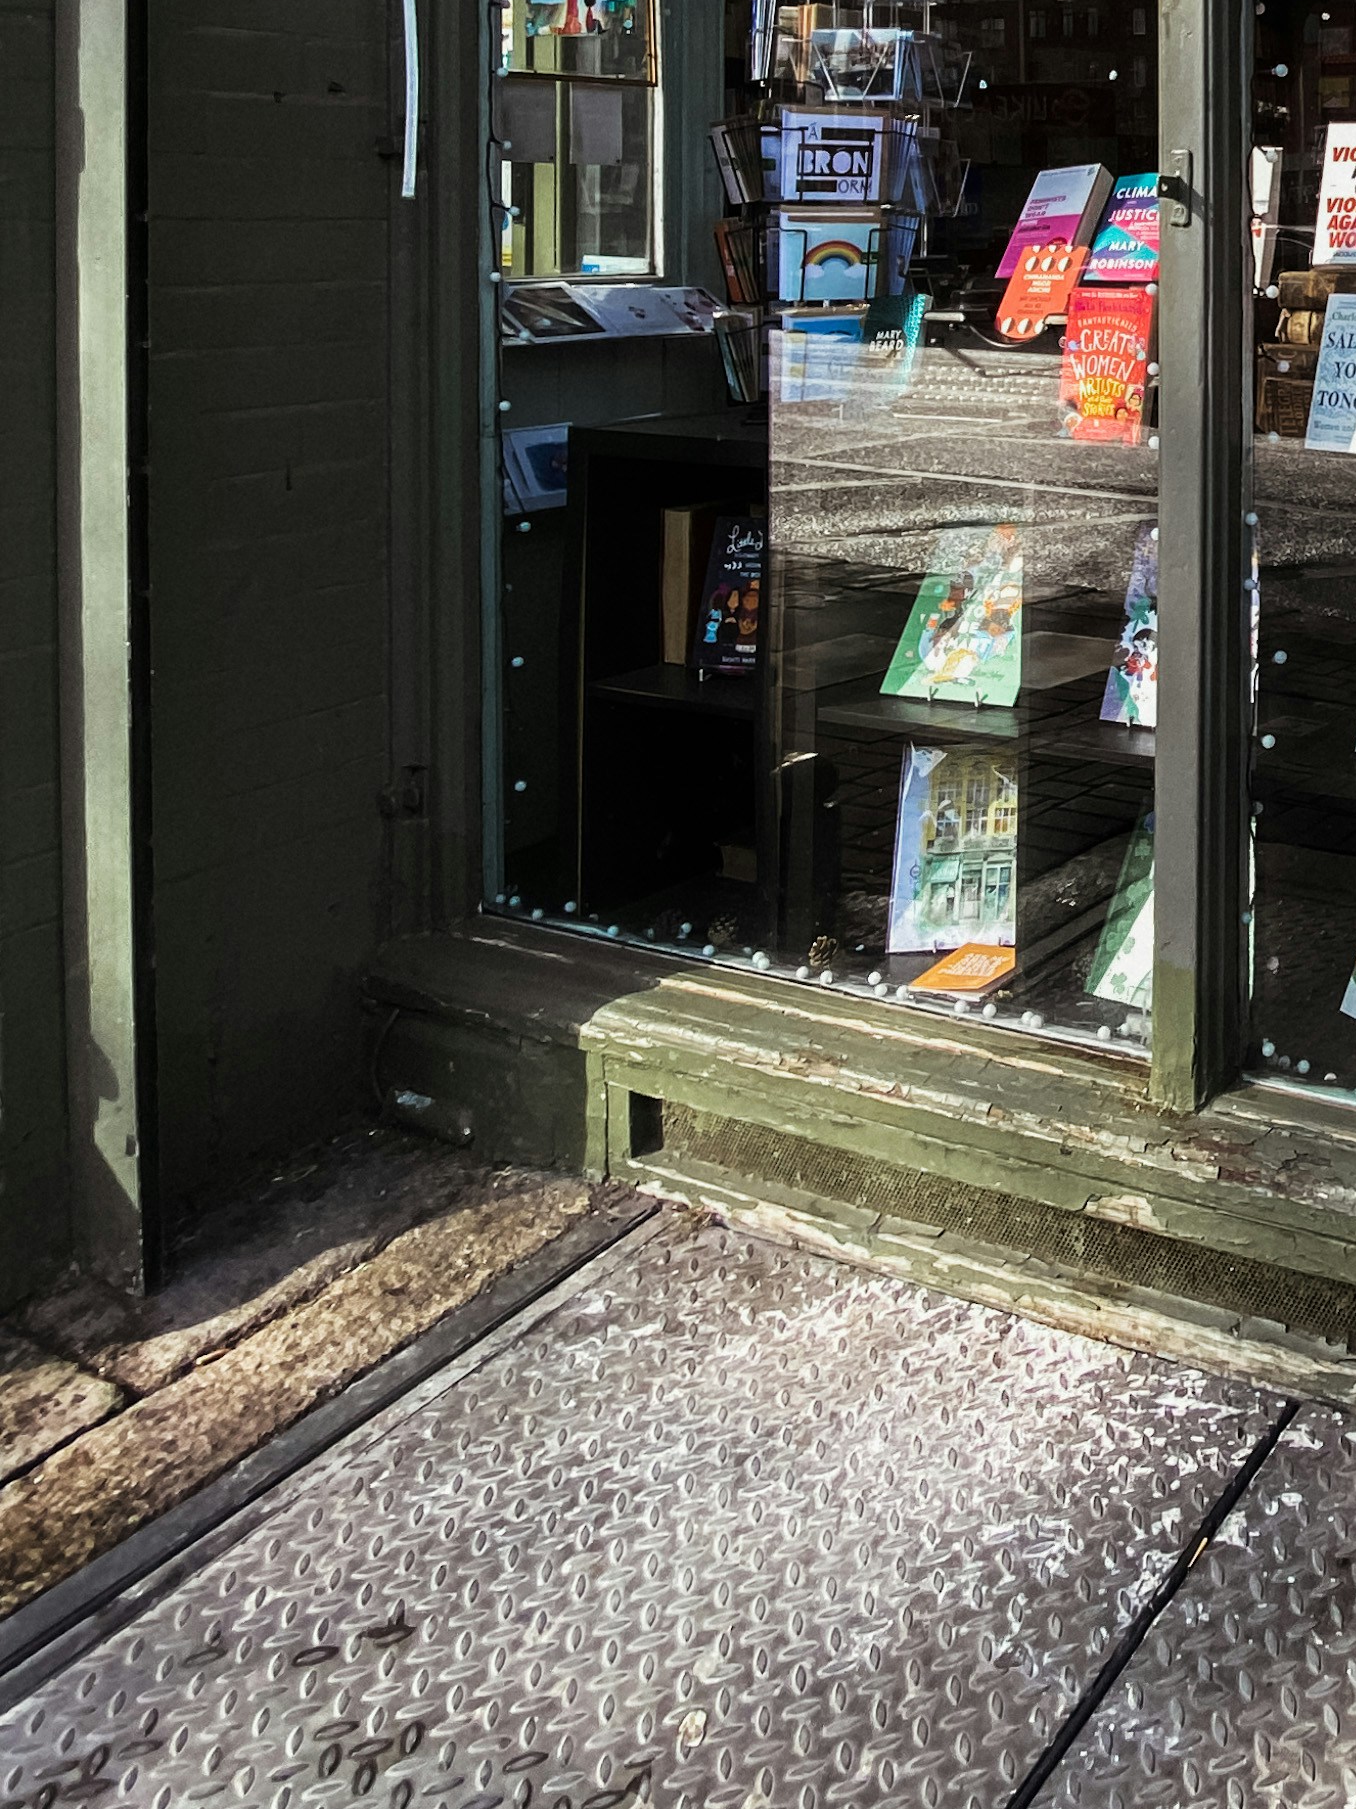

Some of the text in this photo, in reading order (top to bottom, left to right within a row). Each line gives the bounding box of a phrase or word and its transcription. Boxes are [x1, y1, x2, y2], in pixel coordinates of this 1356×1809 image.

[798, 147, 869, 174] BRÓN
[1108, 209, 1159, 222] JUSTIC
[1109, 241, 1144, 251] MARY
[1090, 259, 1154, 270] ROBINSON
[876, 330, 902, 340] MARY
[1080, 328, 1132, 355] GREAT
[869, 339, 904, 352] BEARD
[1069, 353, 1136, 382] WOMEN
[1079, 378, 1125, 401] ARTISTS
[1313, 420, 1340, 431] Women
[1342, 422, 1356, 432] and
